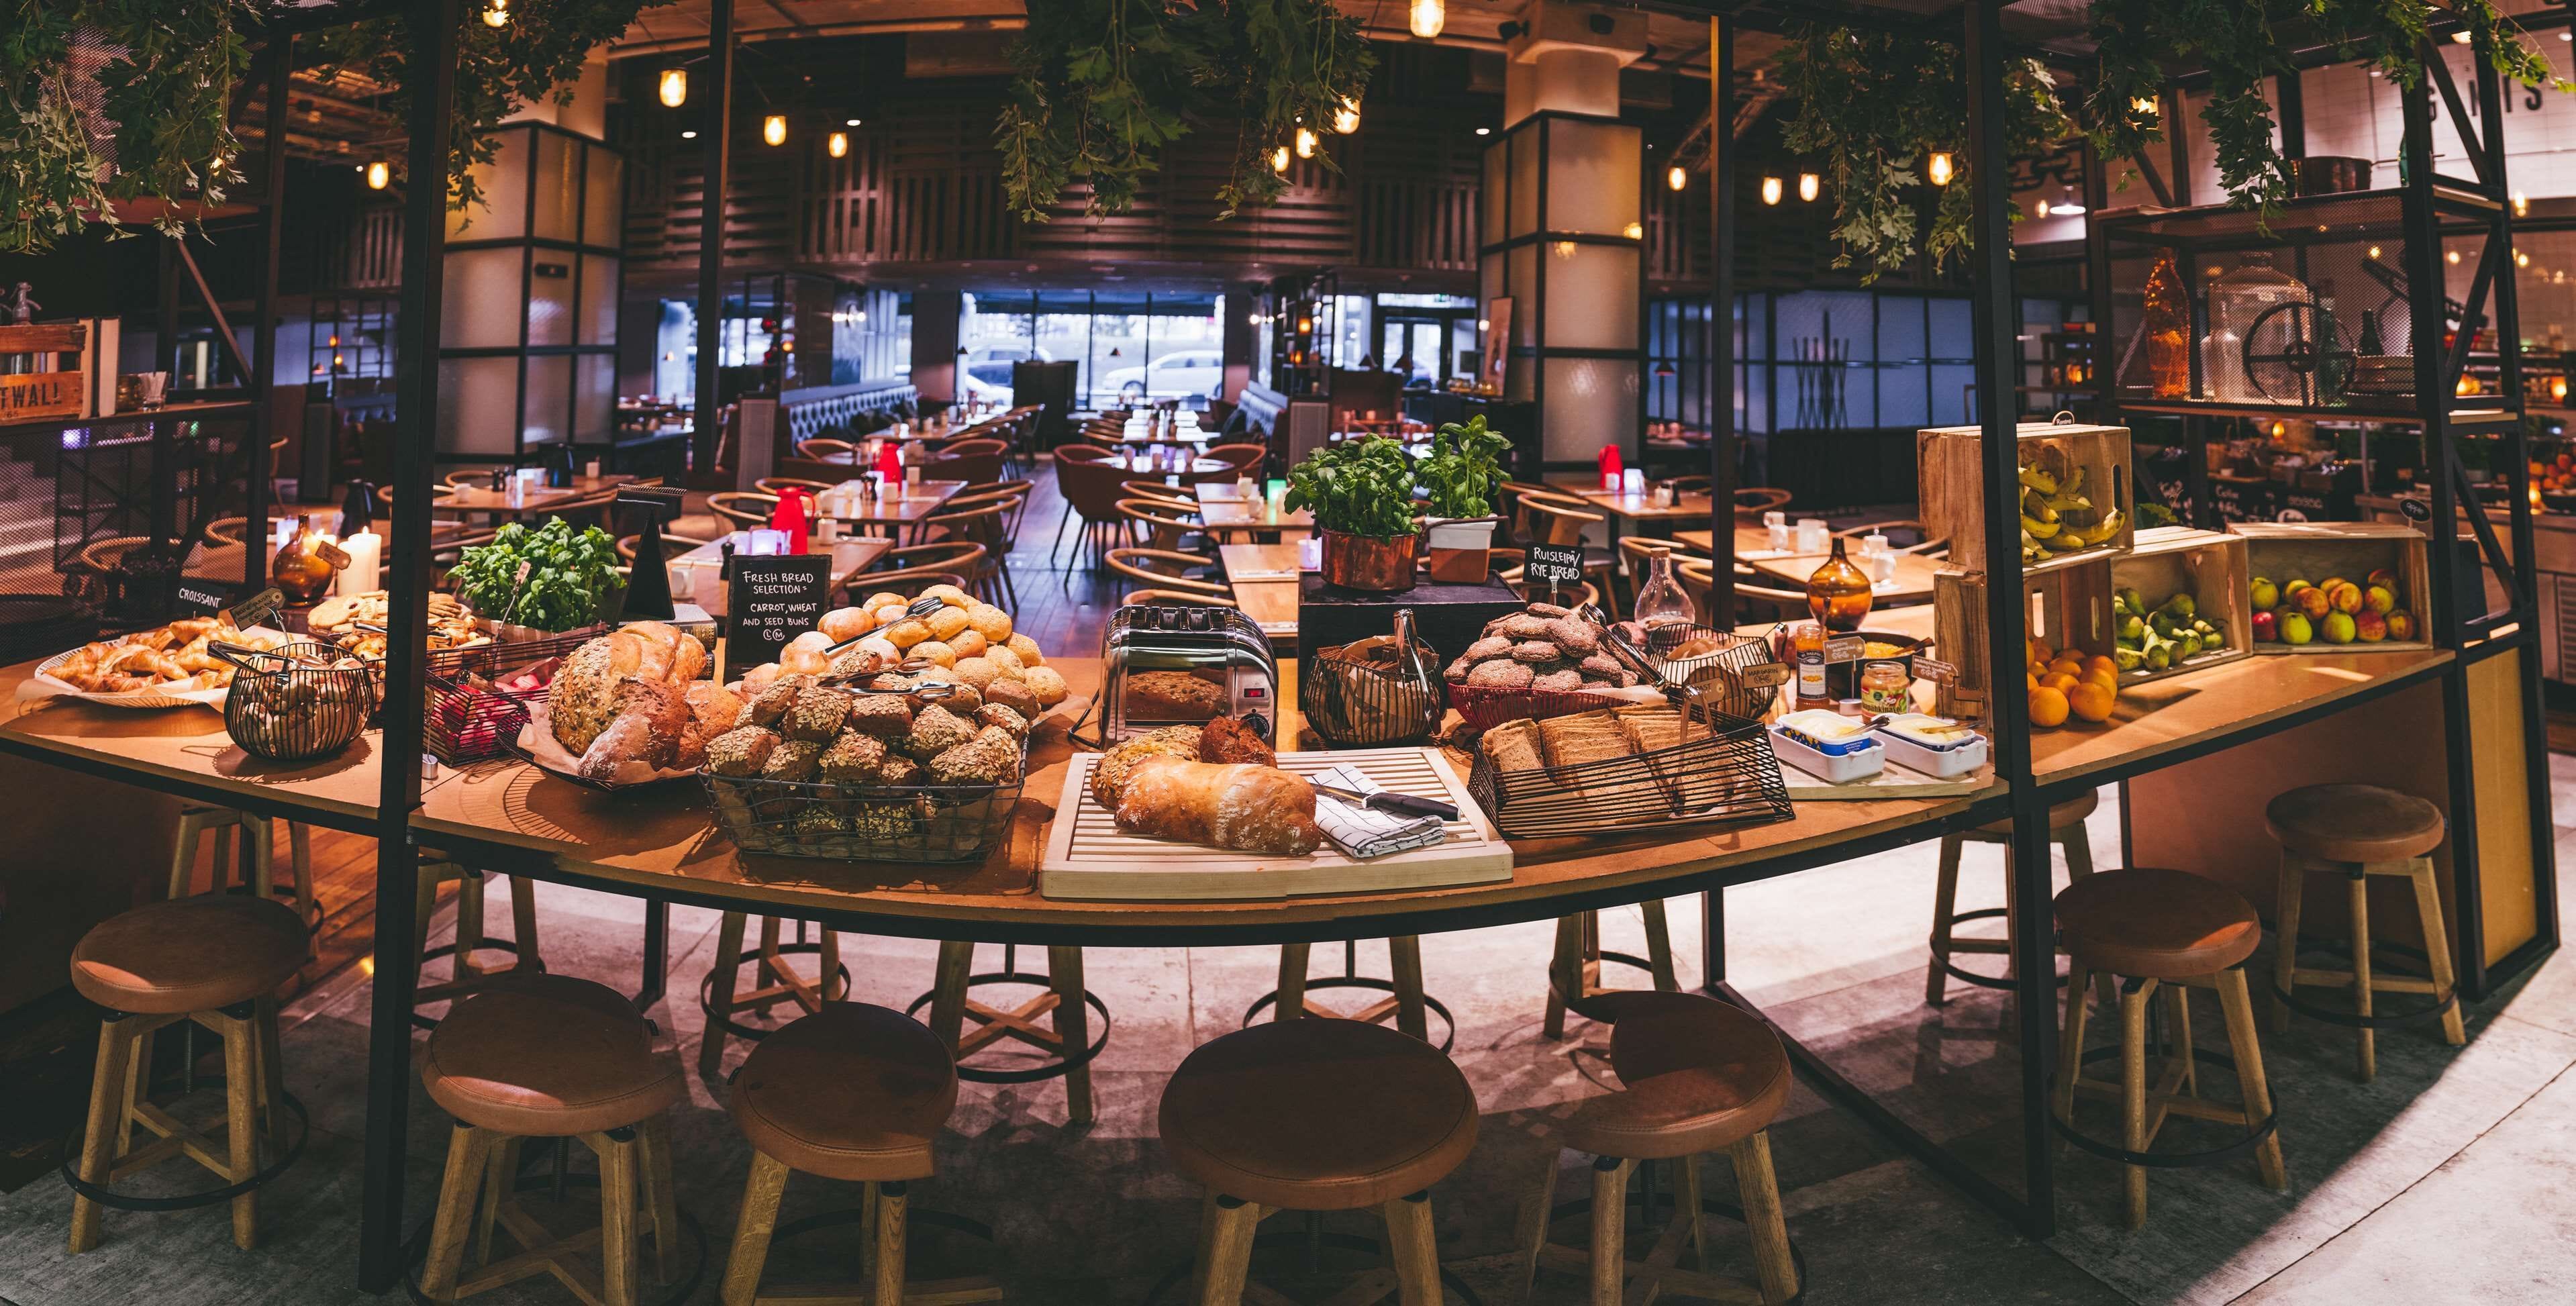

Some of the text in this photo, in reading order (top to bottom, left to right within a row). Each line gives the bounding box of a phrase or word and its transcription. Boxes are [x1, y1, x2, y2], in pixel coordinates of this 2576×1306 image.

[742, 571, 813, 583] FRESH BREAD
[1531, 562, 1580, 580] RYE BREAD
[179, 587, 222, 608] CROISSANT
[743, 617, 809, 626] AND SEED BUNS
